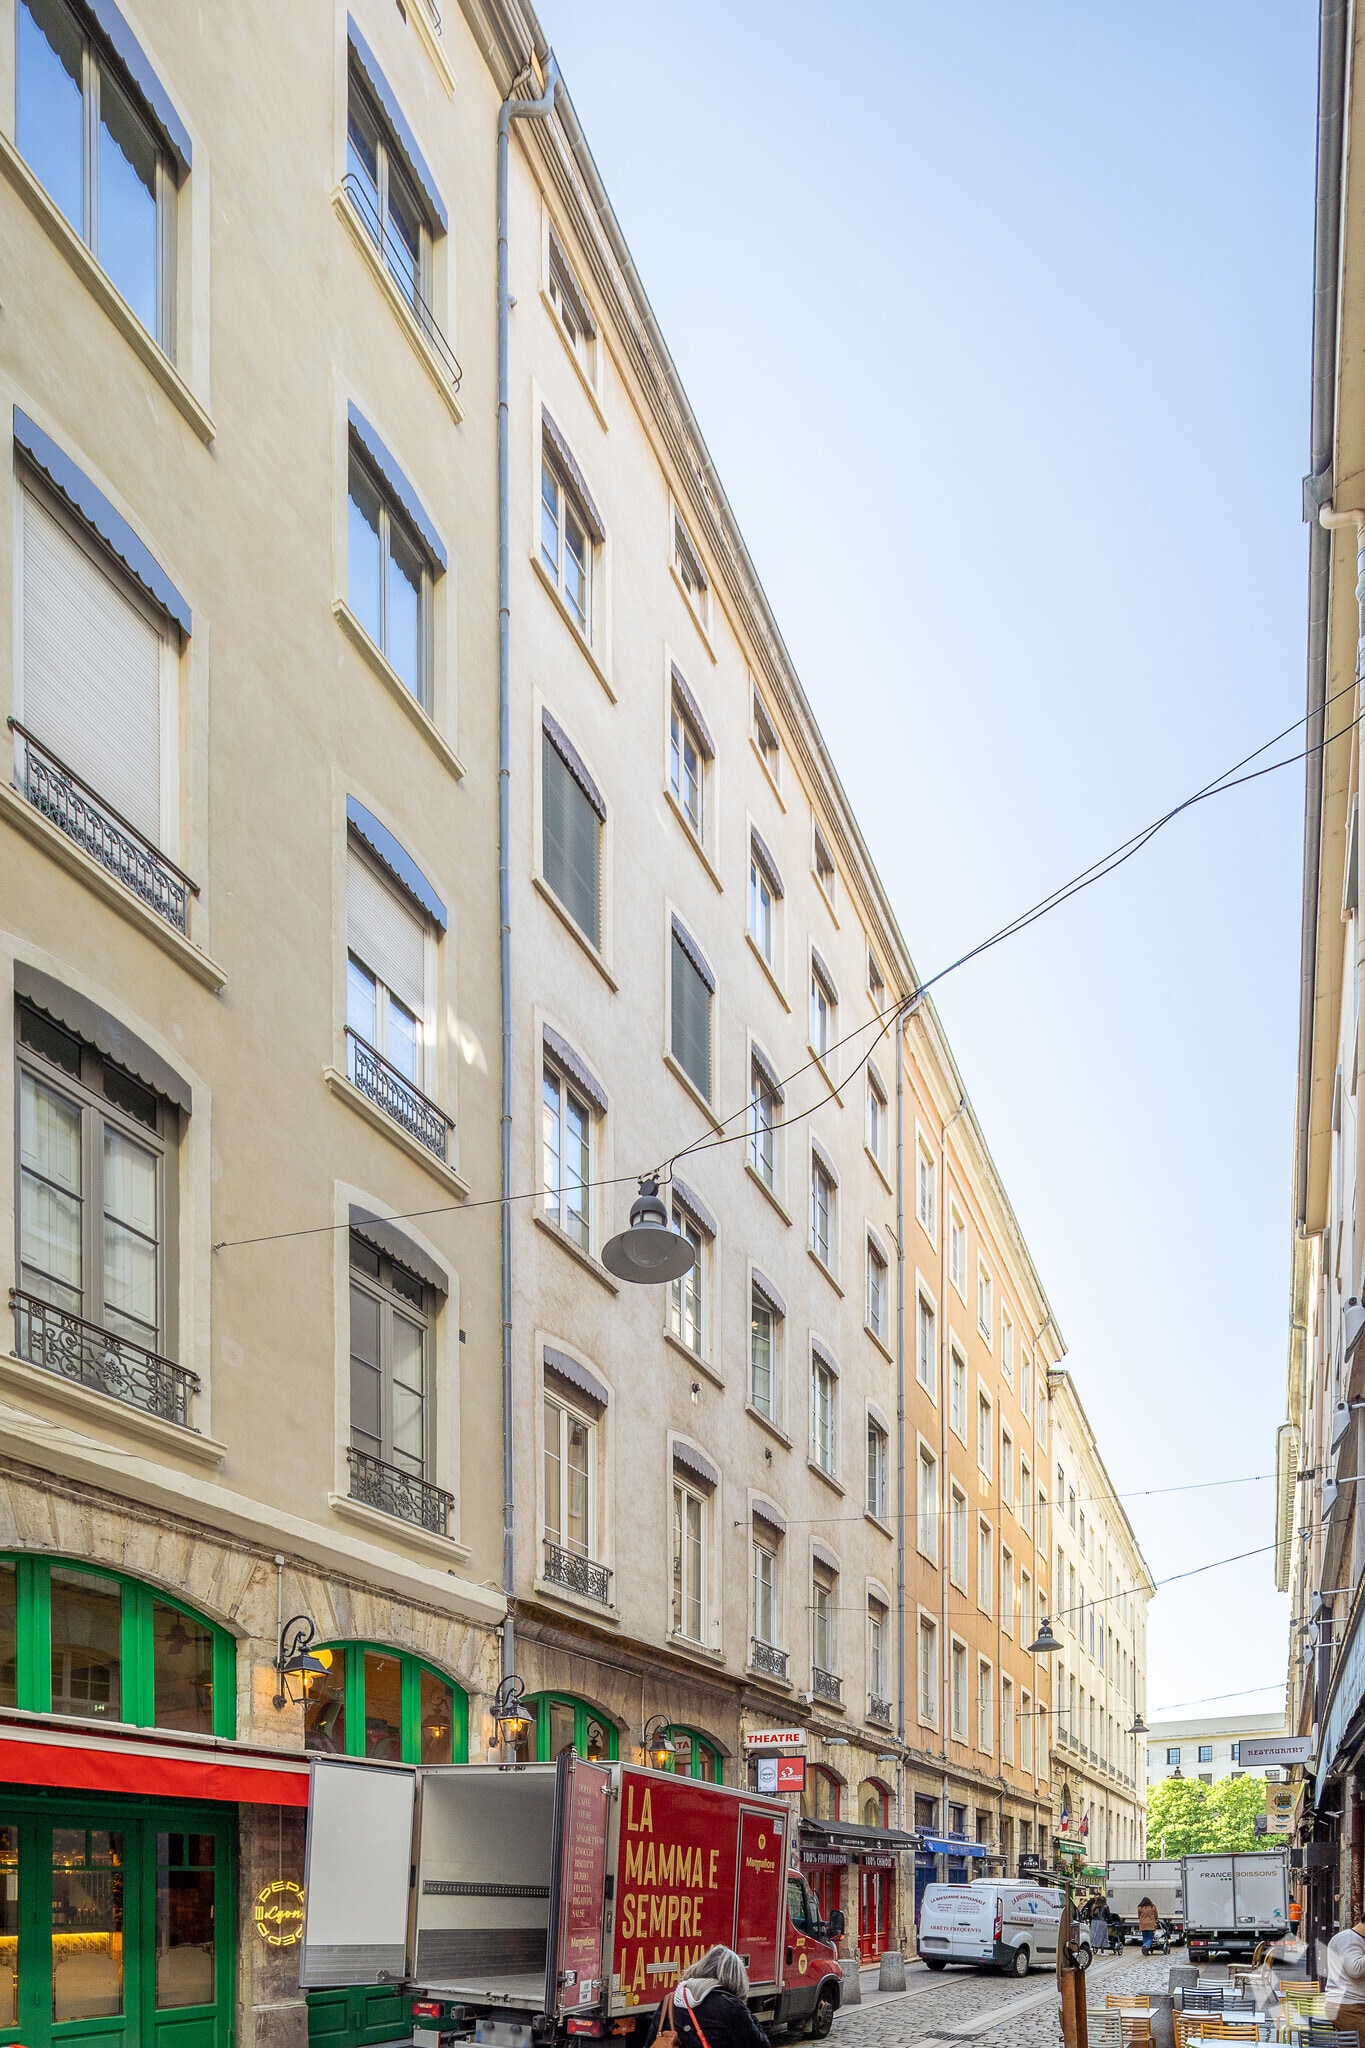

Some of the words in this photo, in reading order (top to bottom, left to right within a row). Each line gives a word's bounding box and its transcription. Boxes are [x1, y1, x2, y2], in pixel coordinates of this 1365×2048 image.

[747, 1733, 800, 1744] THEATRE
[1247, 1747, 1304, 1756] RESTAURANT
[627, 1785, 653, 1833] LA
[574, 1858, 594, 1869] BISCOTTI
[625, 1840, 704, 1888] MAMMA
[708, 1849, 720, 1889] E
[803, 1852, 817, 1863] 100%
[817, 1852, 828, 1864] FAIT
[828, 1853, 847, 1865] MAISON
[865, 1856, 876, 1866] 100%
[1235, 1870, 1277, 1878] BOISSONS
[264, 1905, 303, 1925] Lyon
[623, 1893, 704, 1939] SEMPRE
[620, 1947, 646, 1992] LA
